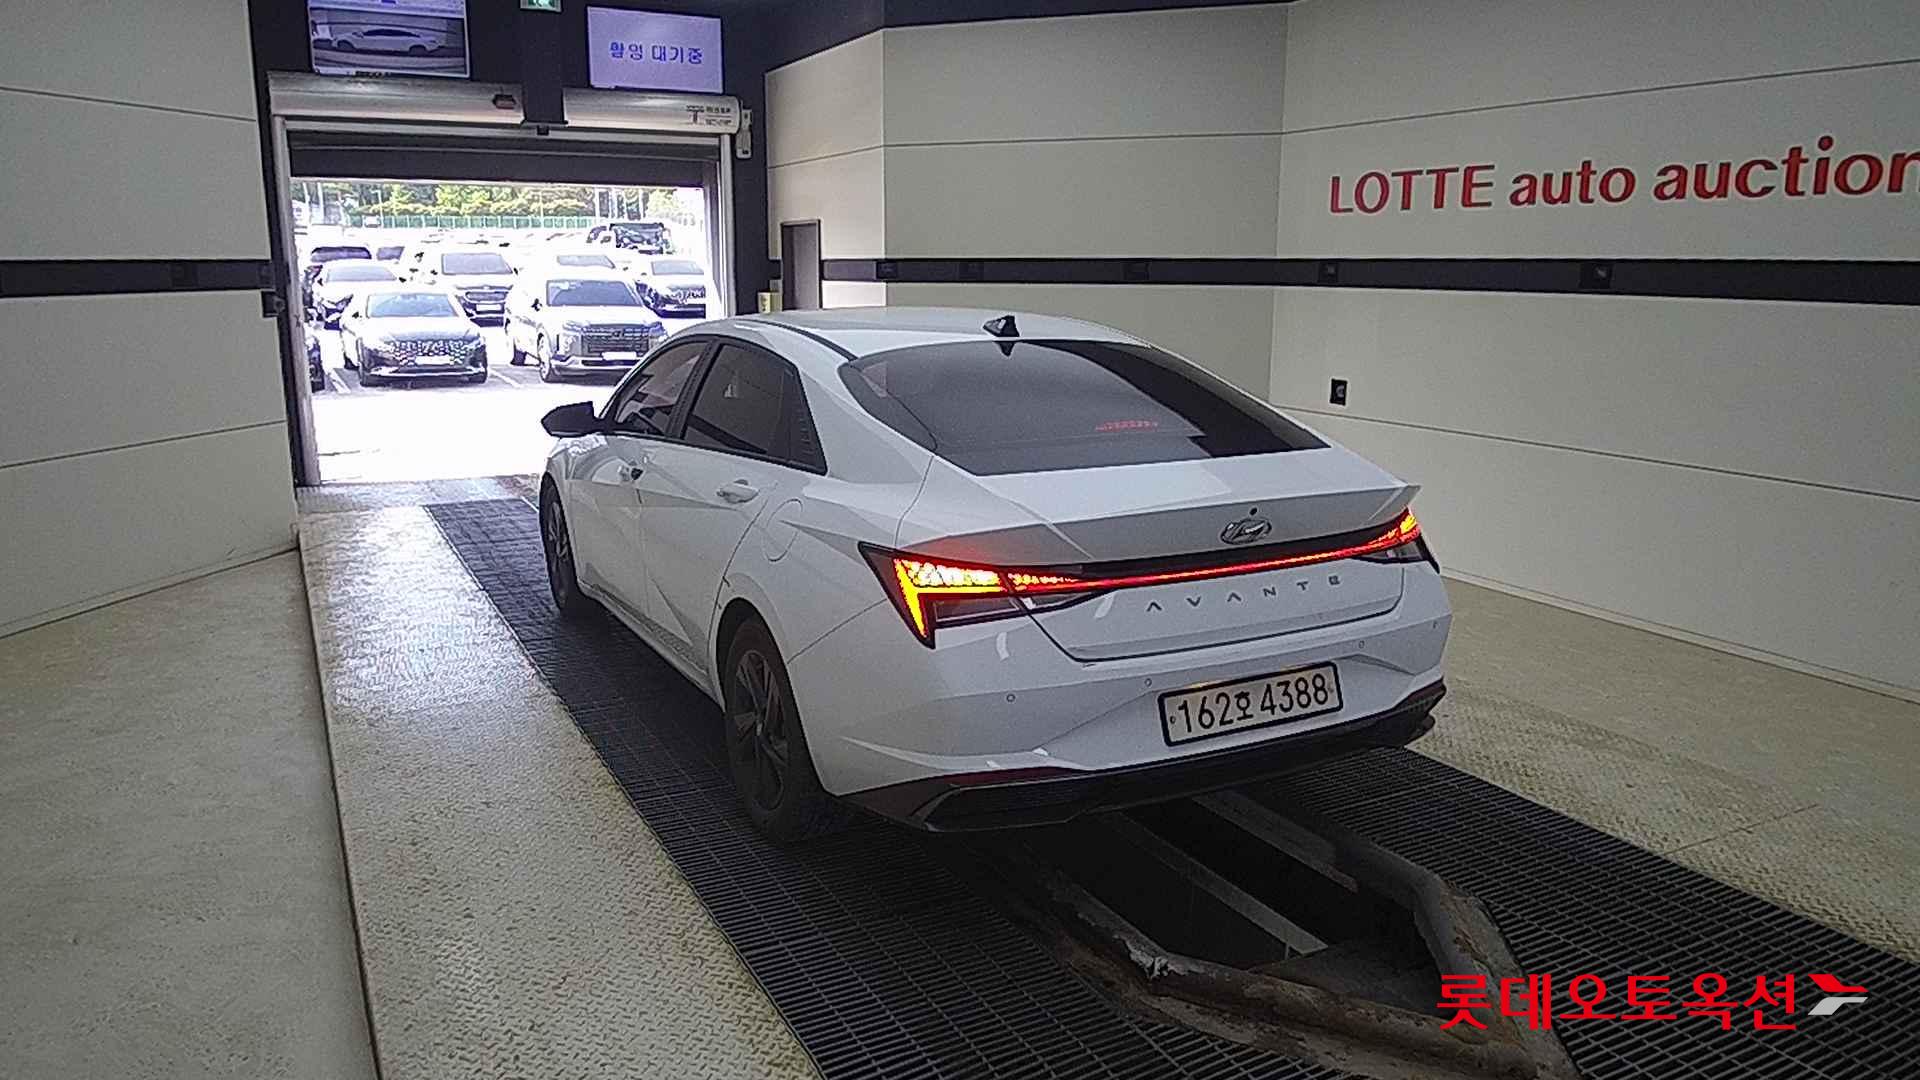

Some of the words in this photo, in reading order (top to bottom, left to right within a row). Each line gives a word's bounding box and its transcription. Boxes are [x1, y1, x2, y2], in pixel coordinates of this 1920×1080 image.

[651, 45, 703, 65] 대기중
[1330, 164, 1495, 213] LOTTE
[1509, 160, 1637, 207] auto
[1147, 575, 1341, 612] AVANTE
[1260, 674, 1328, 716] 4388
